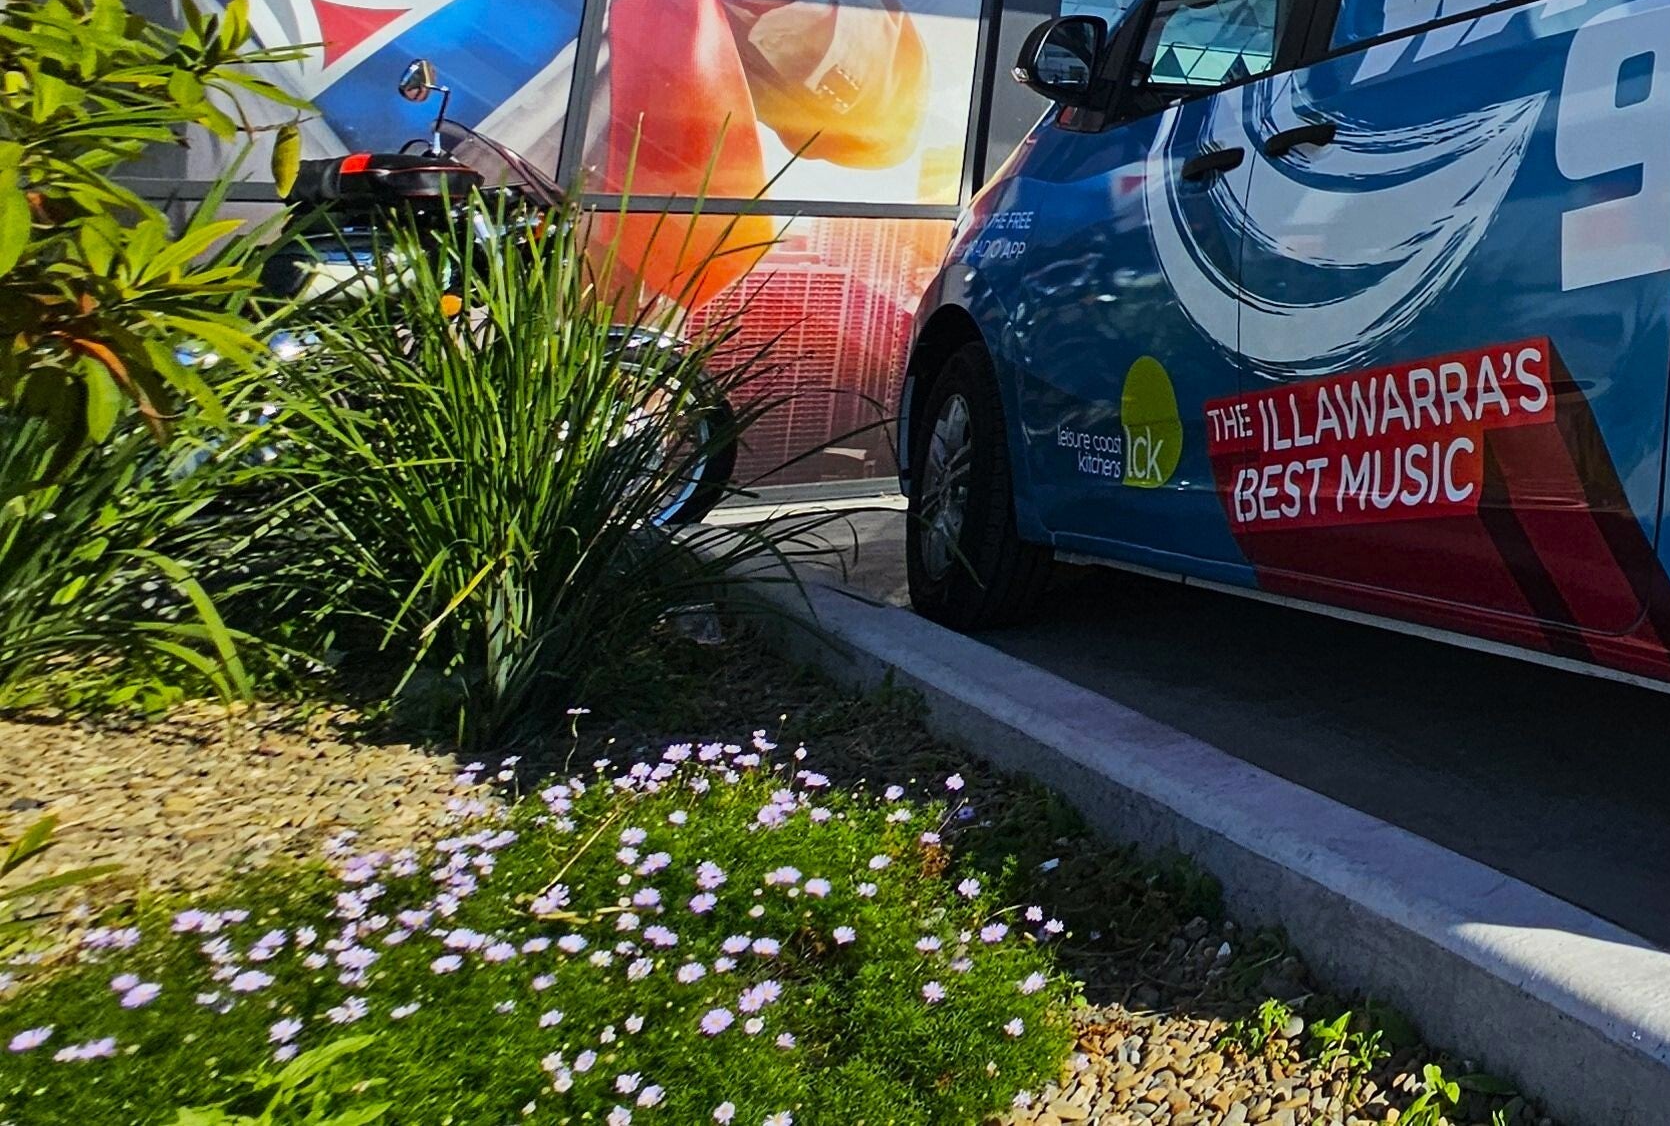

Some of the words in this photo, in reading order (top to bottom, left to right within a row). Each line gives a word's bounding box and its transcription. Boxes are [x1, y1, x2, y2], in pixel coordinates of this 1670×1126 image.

[1006, 211, 1035, 230] FREE
[1000, 241, 1026, 259] APP
[1207, 403, 1253, 442] THE
[1258, 347, 1549, 452] ILLAWARRA'S
[1057, 425, 1091, 449] leisure
[1092, 435, 1122, 455] coast
[1078, 451, 1121, 478] kitchens
[1234, 457, 1329, 523] BEST
[1336, 437, 1475, 514] MUSIC
